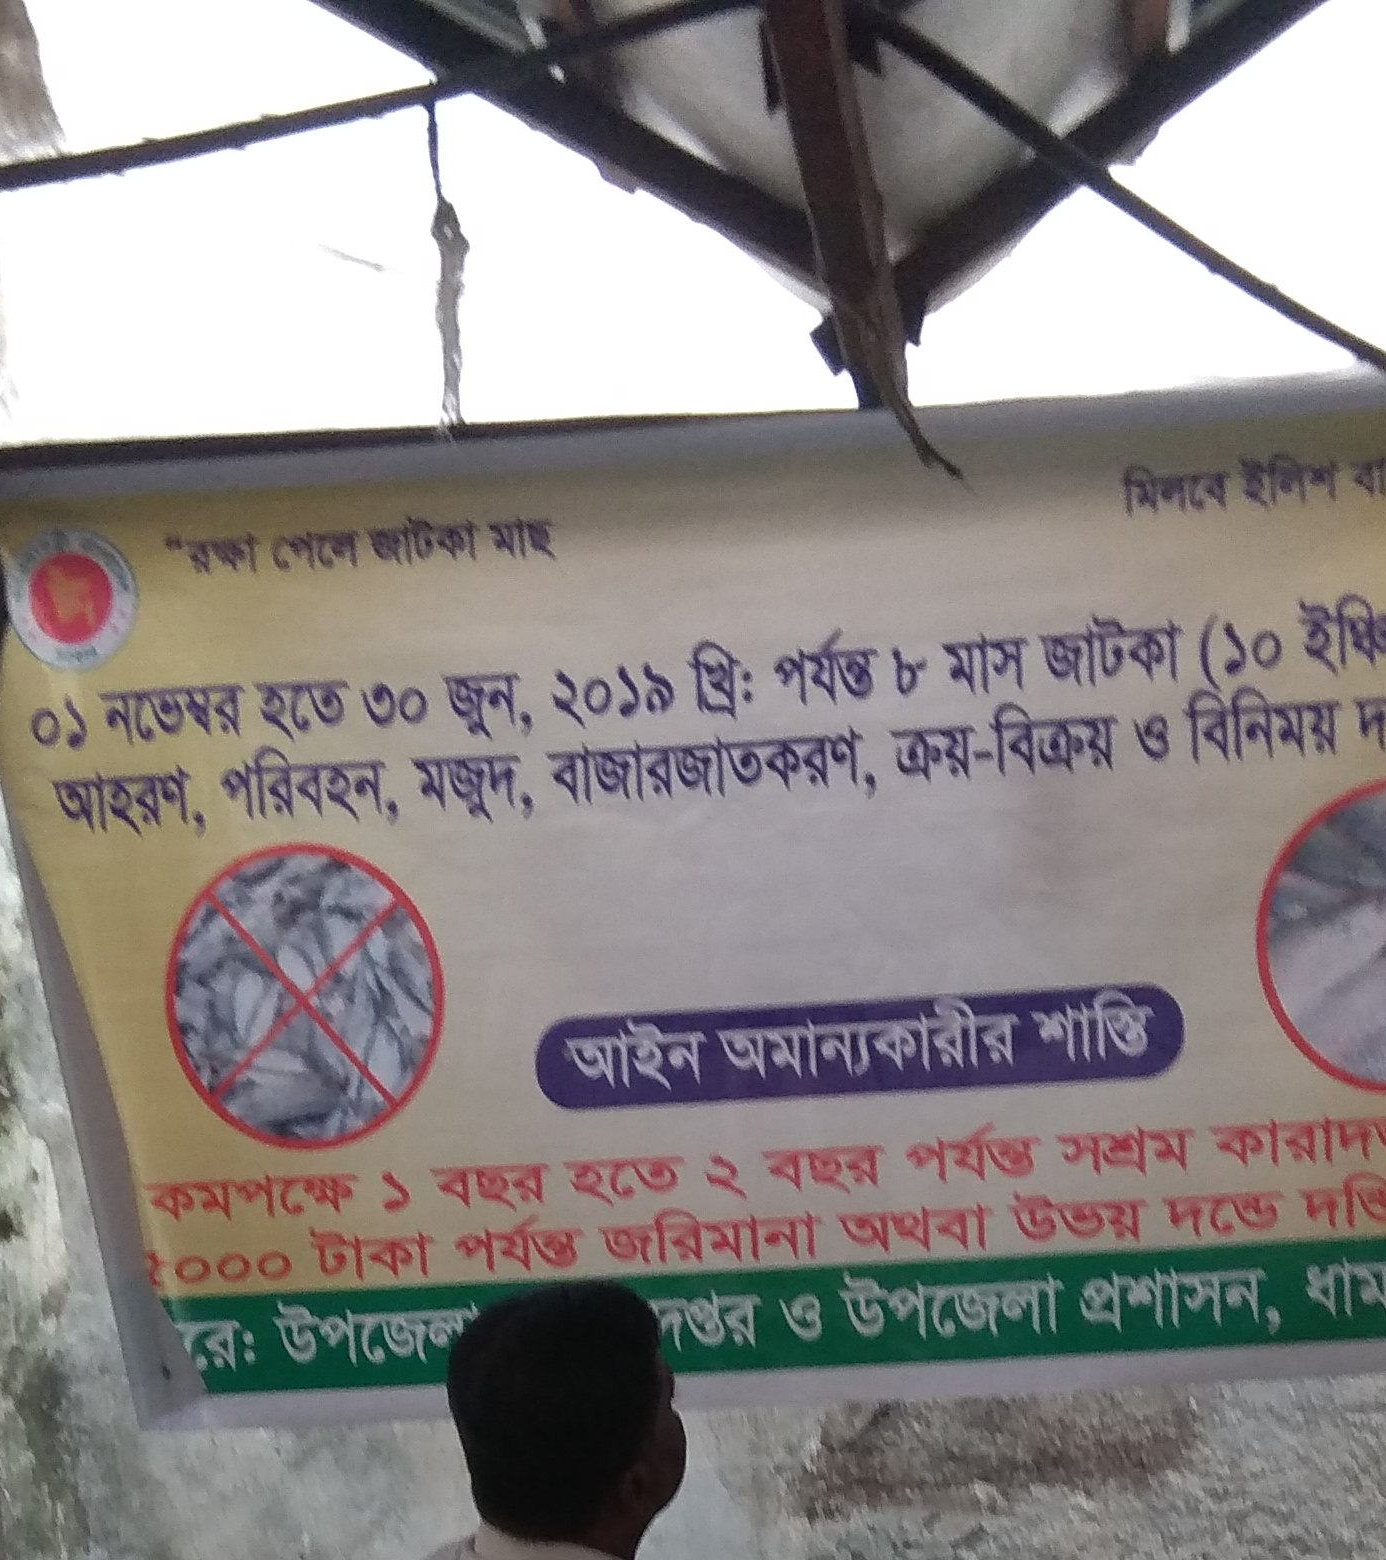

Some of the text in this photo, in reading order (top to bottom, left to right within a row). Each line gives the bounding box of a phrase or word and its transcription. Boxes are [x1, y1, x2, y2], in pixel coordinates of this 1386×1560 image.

[1124, 466, 1226, 516] মিলবে
[1241, 454, 1335, 507] ইলিশ
[274, 533, 357, 570] পেলে
[370, 517, 476, 564] জাটকা
[489, 519, 556, 560] মাছ
[29, 696, 88, 753] ০১
[99, 684, 244, 743] নভেম্বর
[255, 680, 349, 739] হতে
[361, 682, 428, 728] ৩০
[442, 672, 533, 740] জুন,
[552, 662, 675, 728] ২০১৯
[773, 629, 878, 705] পর্যন্ত
[941, 633, 1028, 694] মাস
[1039, 614, 1182, 686] জাটকা
[1197, 614, 1283, 688] (১০
[53, 765, 205, 835] আহরণ,
[221, 747, 399, 824] পরিবহন,
[411, 754, 533, 823] মজুদ,
[546, 726, 877, 804] বাজারজাতকরণ,
[889, 702, 1118, 782] ক্রয়-বিক্রয়
[1133, 714, 1170, 762] ও
[1186, 686, 1339, 763] বিনিময়
[565, 991, 1155, 1092] আইন অমান্যকারীর শাস্তি
[145, 1171, 356, 1222] কমপক্ষে
[383, 1170, 412, 1213] ১
[431, 1162, 551, 1211] বছর
[565, 1154, 686, 1207] হতে
[703, 1154, 746, 1198] ২
[764, 1144, 885, 1191] বছর
[906, 1122, 1042, 1184] পর্যন্ত
[1056, 1126, 1194, 1175] সশ্রম
[311, 1229, 435, 1281] টাকা
[455, 1214, 583, 1274] পর্যন্ত
[599, 1211, 820, 1267] জরিমানা
[838, 1206, 991, 1252] অথবা
[1011, 1188, 1146, 1243] উভয়
[272, 1299, 479, 1368] উপজেল
[780, 1294, 821, 1341] ও
[840, 1272, 1063, 1338] উপজেলা
[1078, 1265, 1282, 1335] প্রশাসন,
